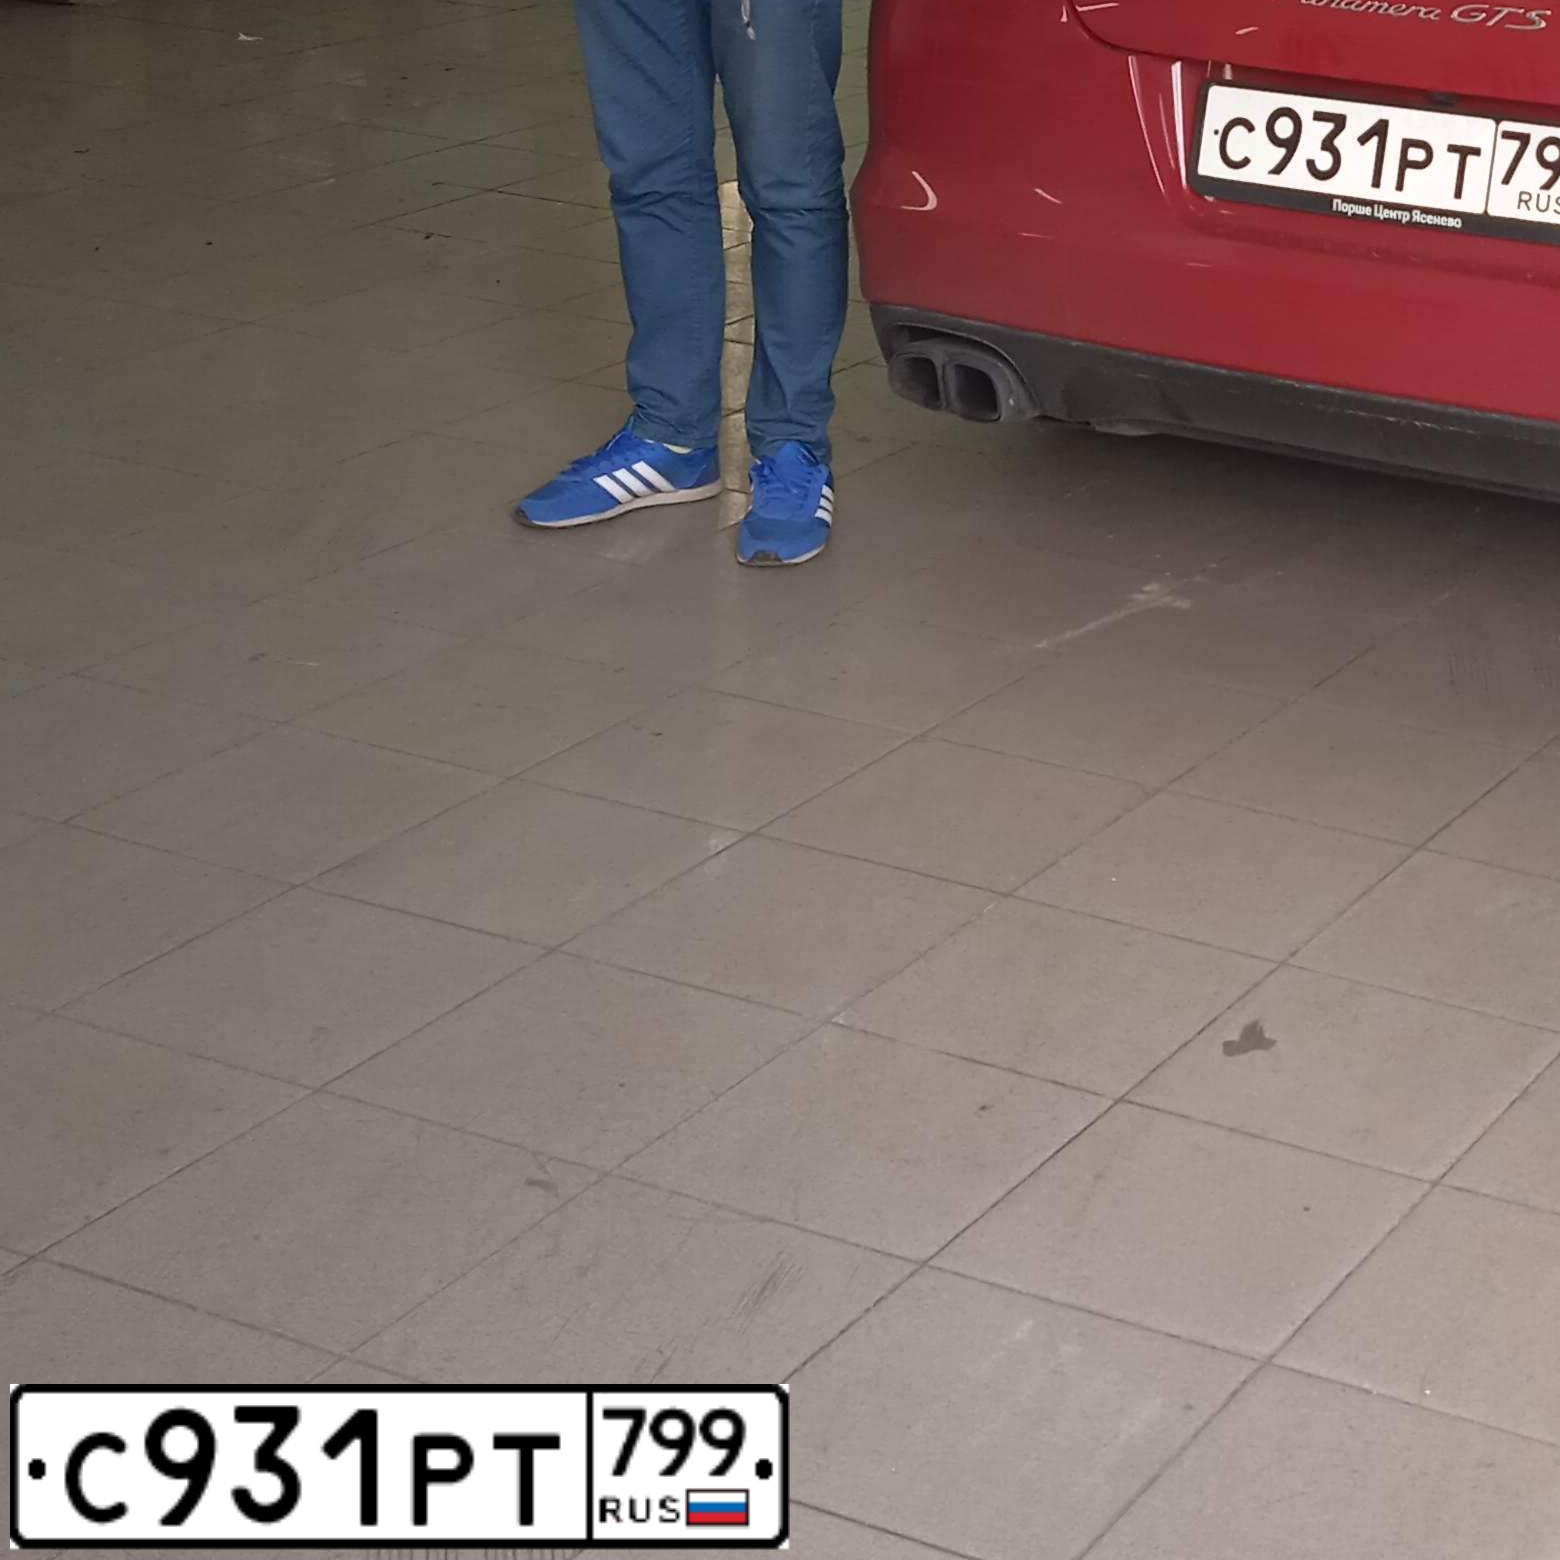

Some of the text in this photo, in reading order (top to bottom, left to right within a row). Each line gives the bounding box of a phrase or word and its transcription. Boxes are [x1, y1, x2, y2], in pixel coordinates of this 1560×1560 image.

[1450, 3, 1553, 30] GTS
[1218, 106, 1482, 200] С931РТ
[1332, 198, 1463, 228] Порше Центр Ясенево
